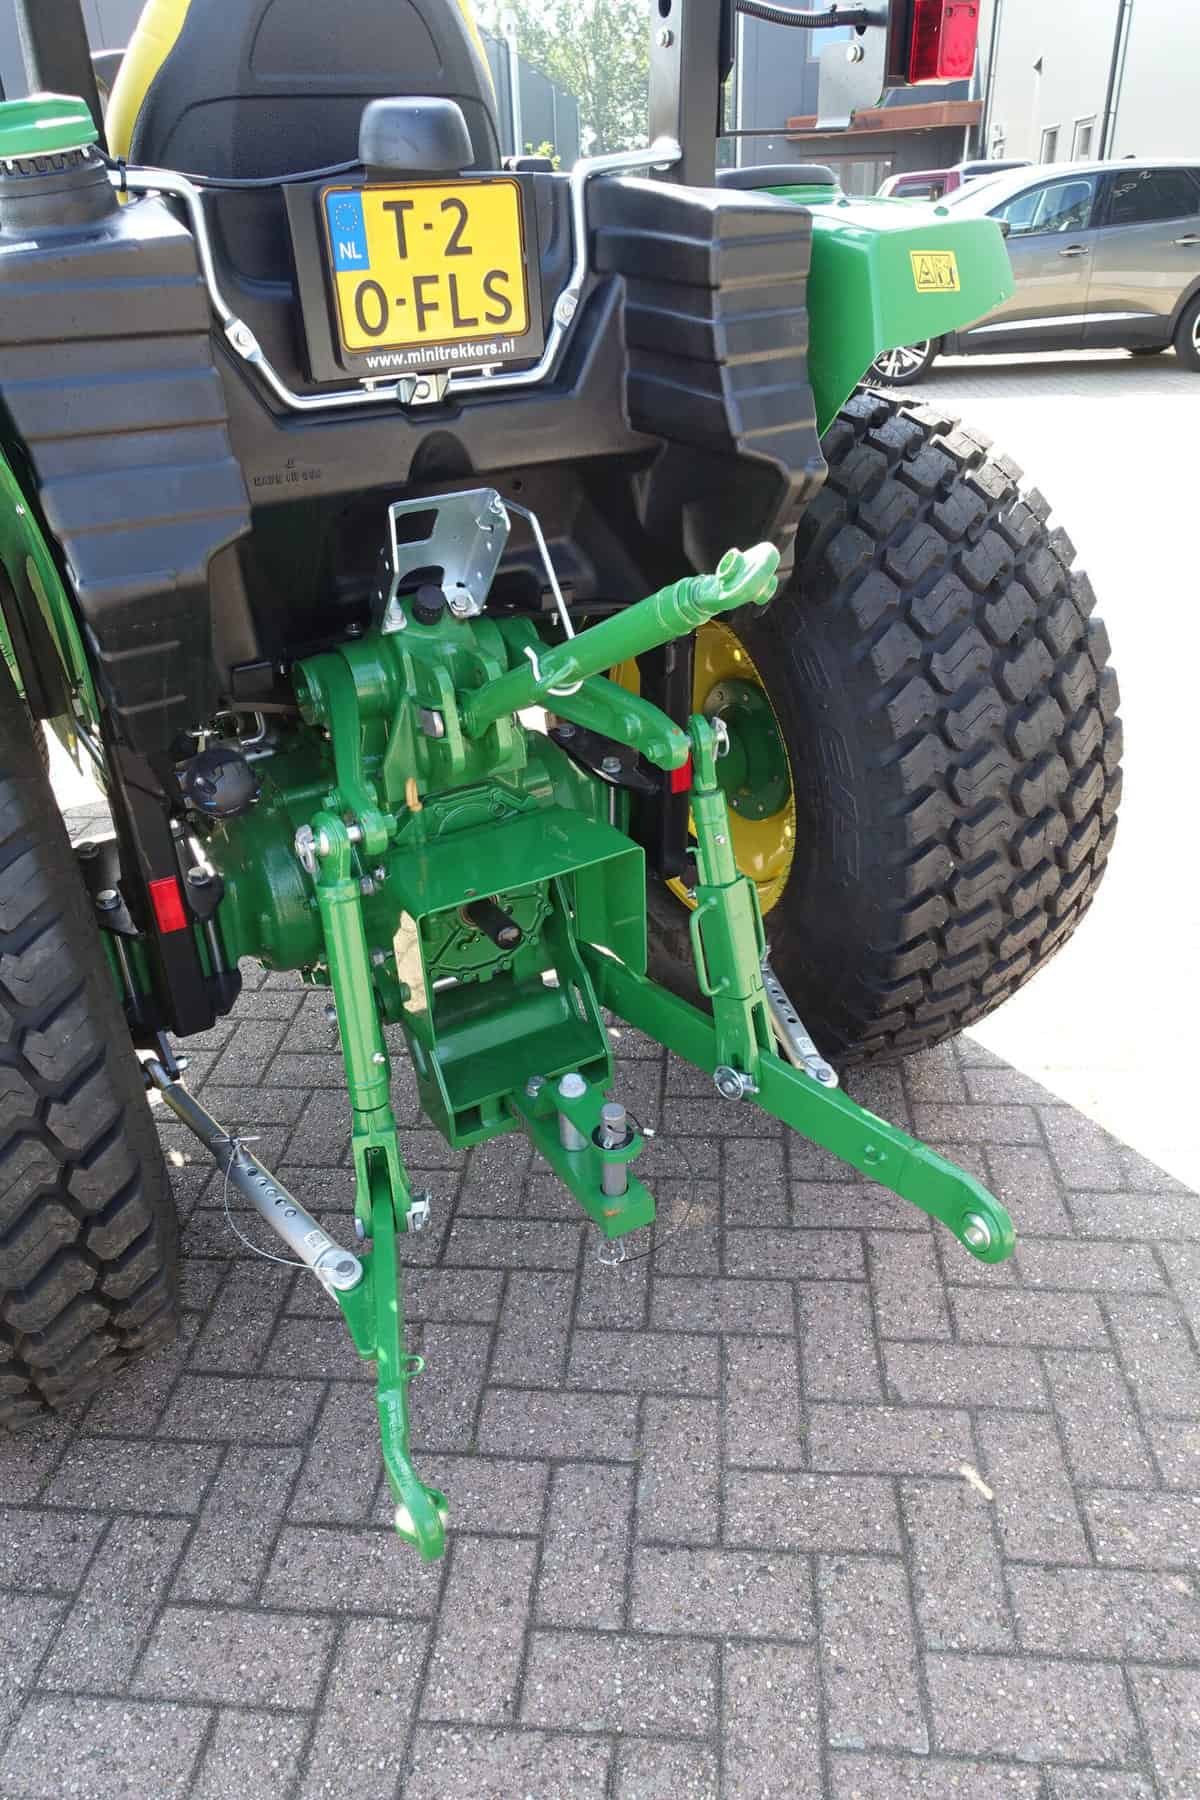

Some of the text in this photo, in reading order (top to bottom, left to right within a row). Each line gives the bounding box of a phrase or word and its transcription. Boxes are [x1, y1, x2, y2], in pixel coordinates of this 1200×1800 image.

[382, 197, 472, 259] T-2
[339, 242, 362, 259] NL
[366, 340, 515, 368] www.minitrekkers.nl
